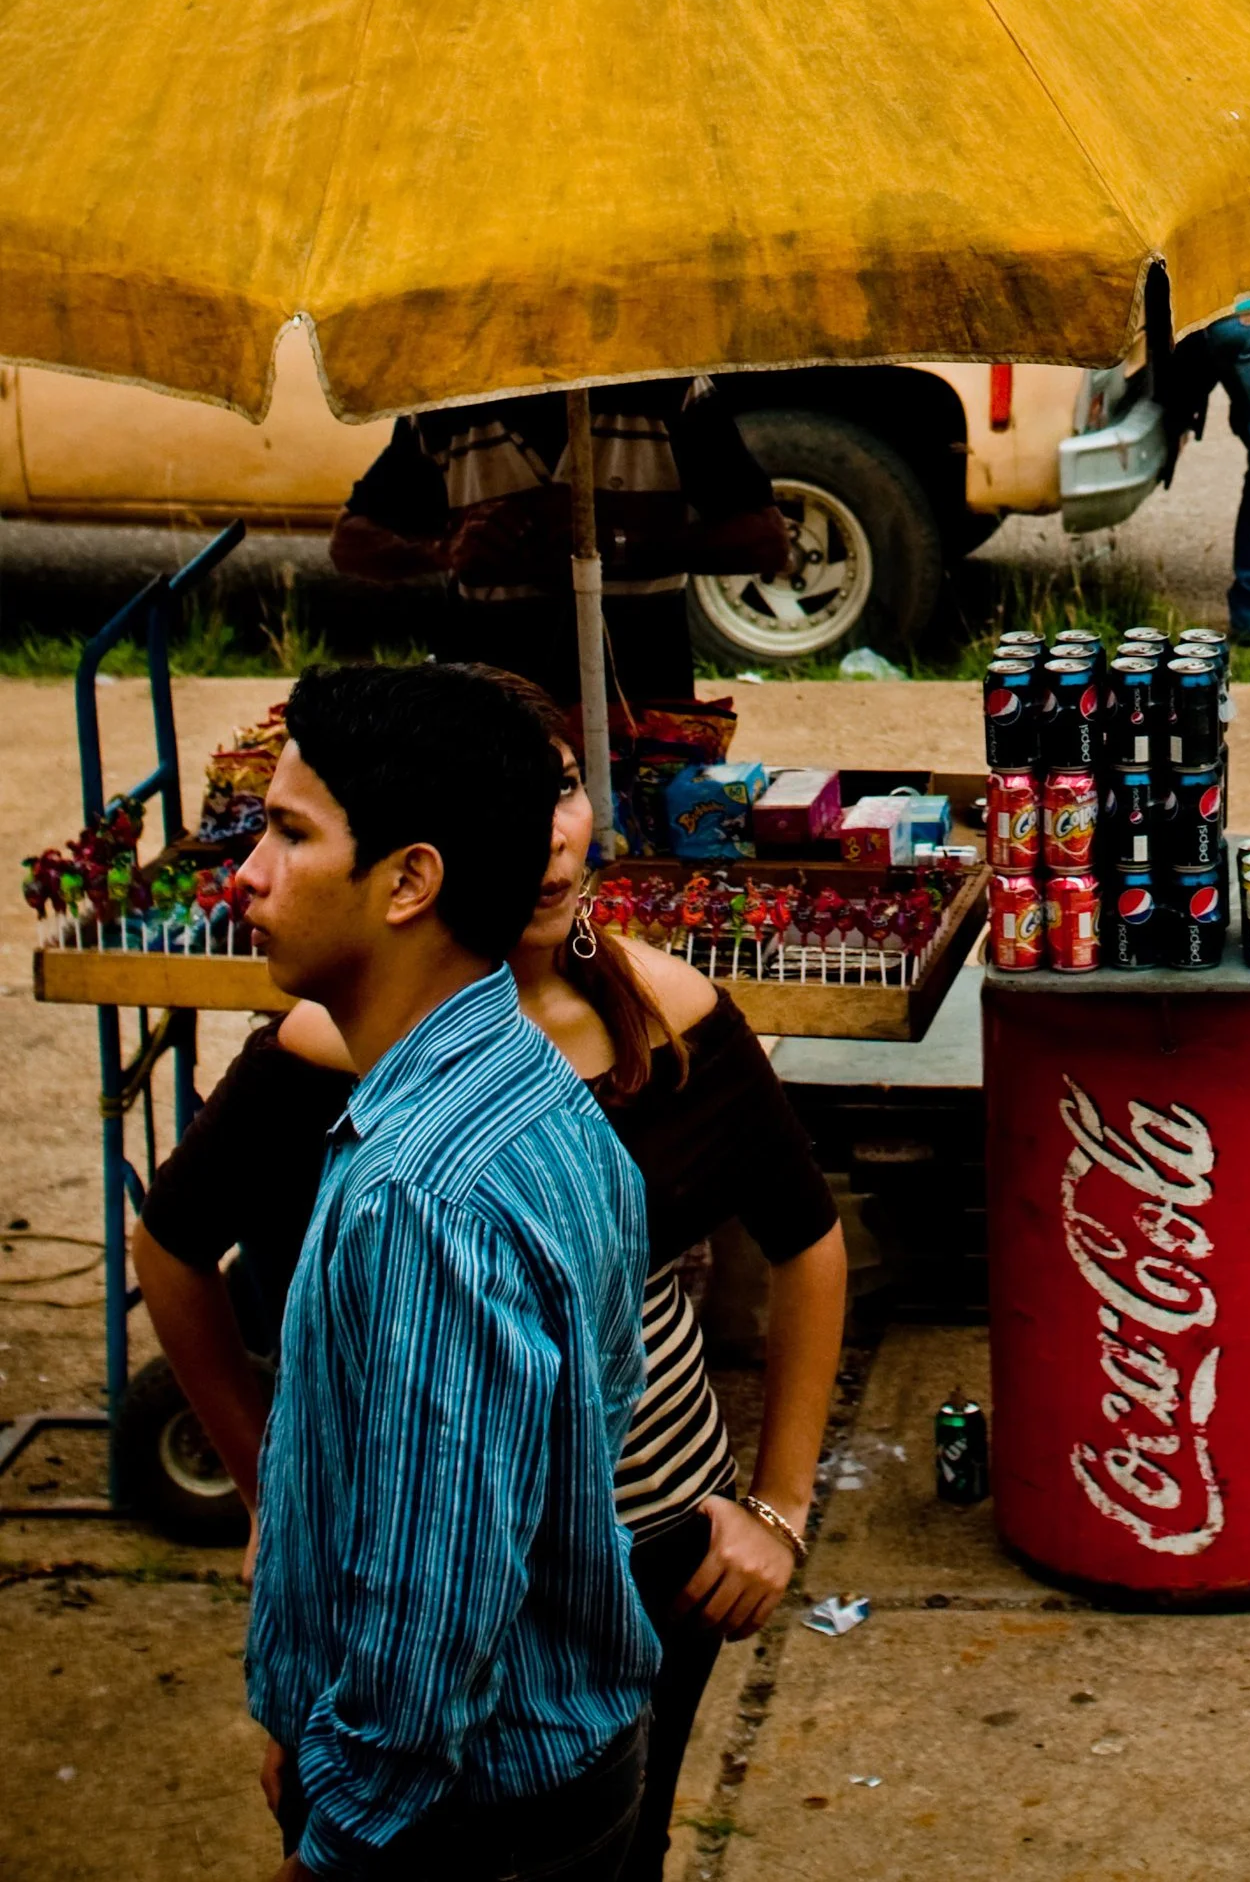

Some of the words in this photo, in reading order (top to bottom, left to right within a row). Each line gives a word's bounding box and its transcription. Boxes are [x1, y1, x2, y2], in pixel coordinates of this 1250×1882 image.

[1078, 723, 1092, 763] pepsi
[1197, 824, 1210, 863] pepsi
[1117, 923, 1129, 962] pepsi
[1188, 924, 1202, 963] pepsi
[1058, 1073, 1225, 1556] Coca-Cola
